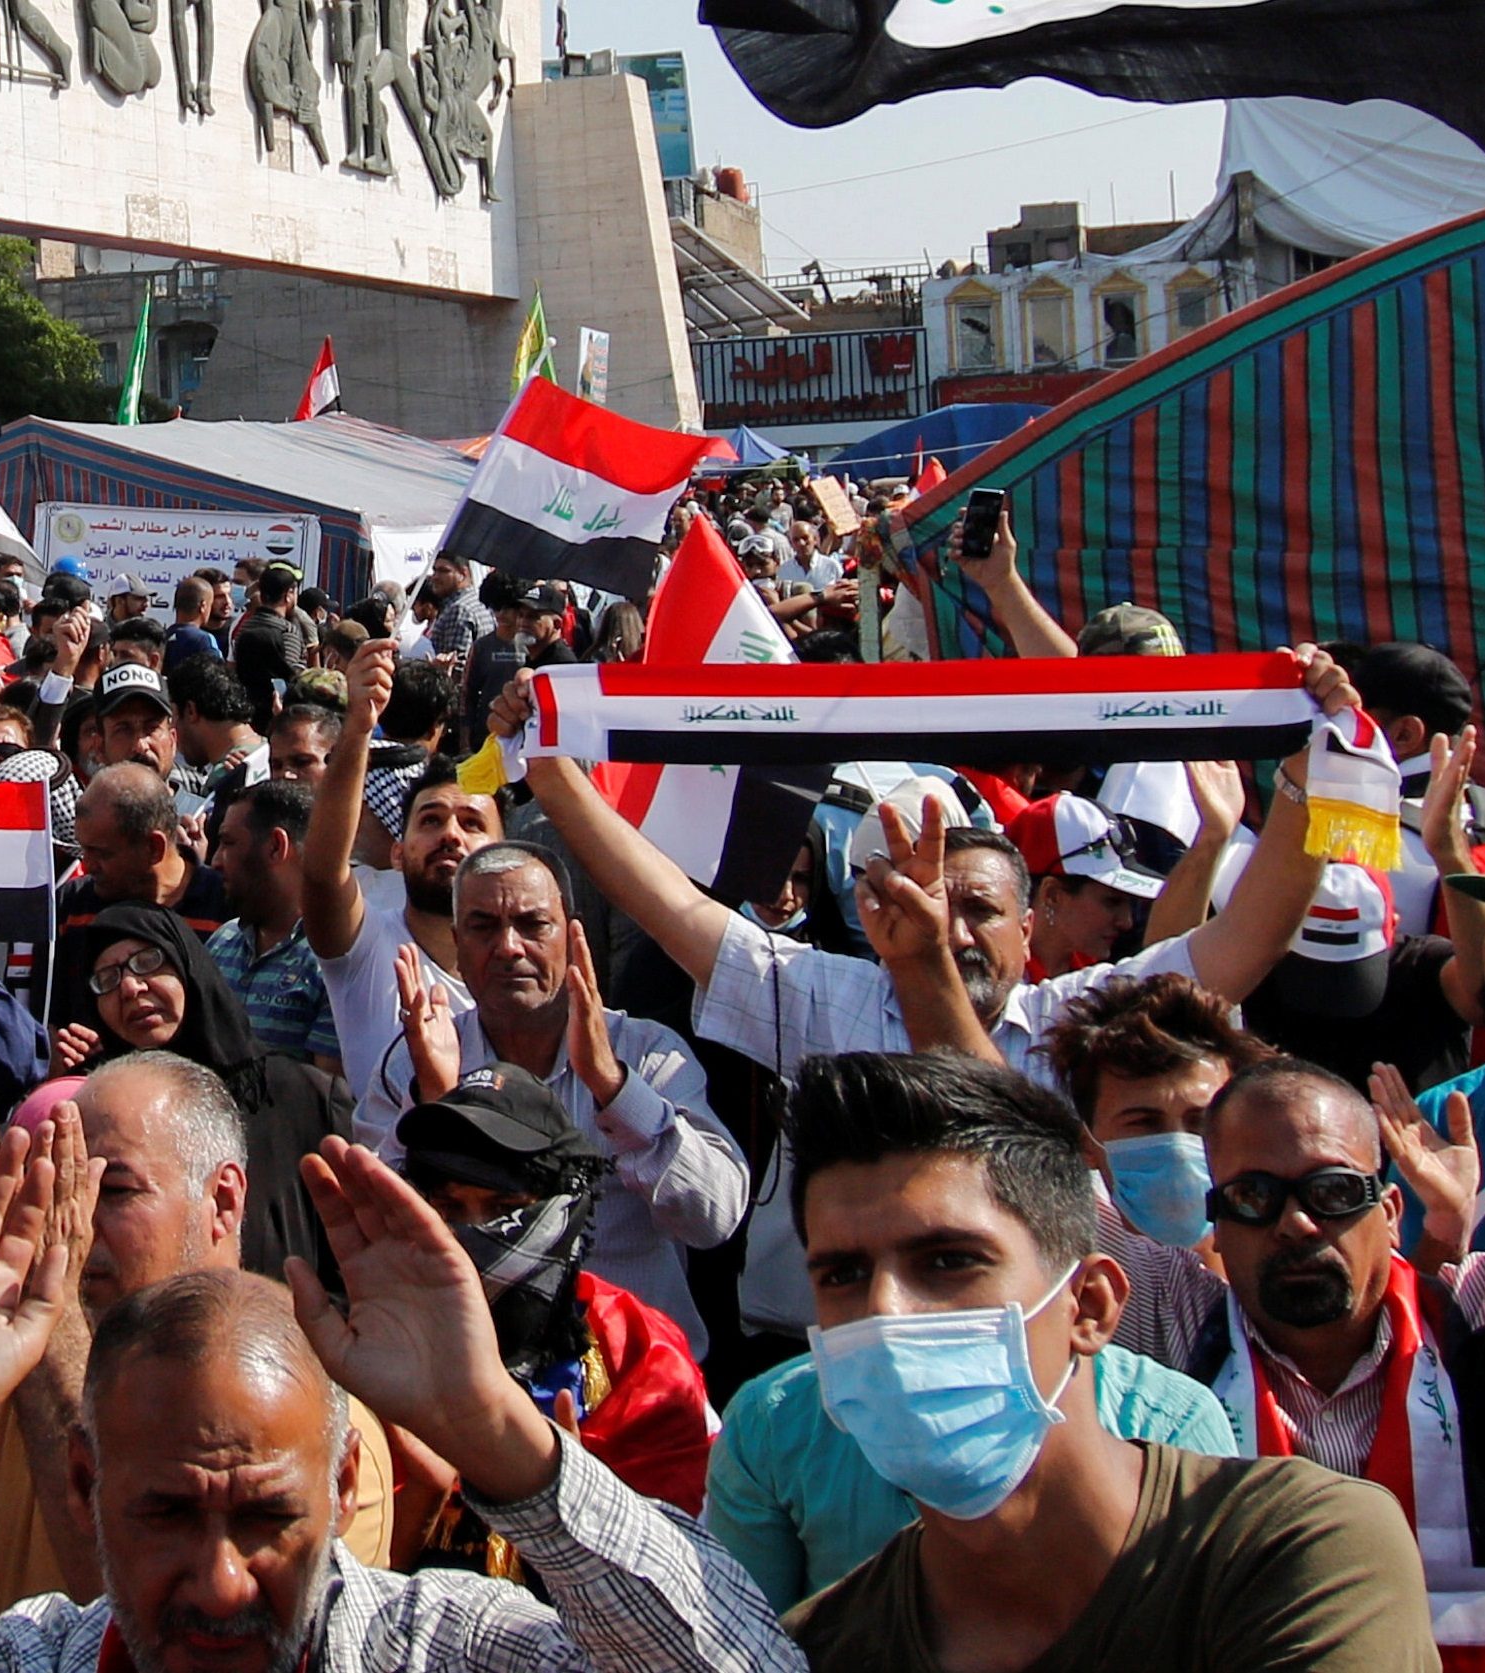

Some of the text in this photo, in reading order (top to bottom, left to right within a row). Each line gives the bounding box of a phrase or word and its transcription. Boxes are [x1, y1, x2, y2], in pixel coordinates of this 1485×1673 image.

[89, 517, 127, 533] الشعب
[129, 521, 168, 536] مطالب
[83, 541, 133, 558] العراقيين
[135, 545, 193, 562] الحقوقيين
[195, 547, 226, 562] اتحاد
[107, 669, 155, 688] NONO
